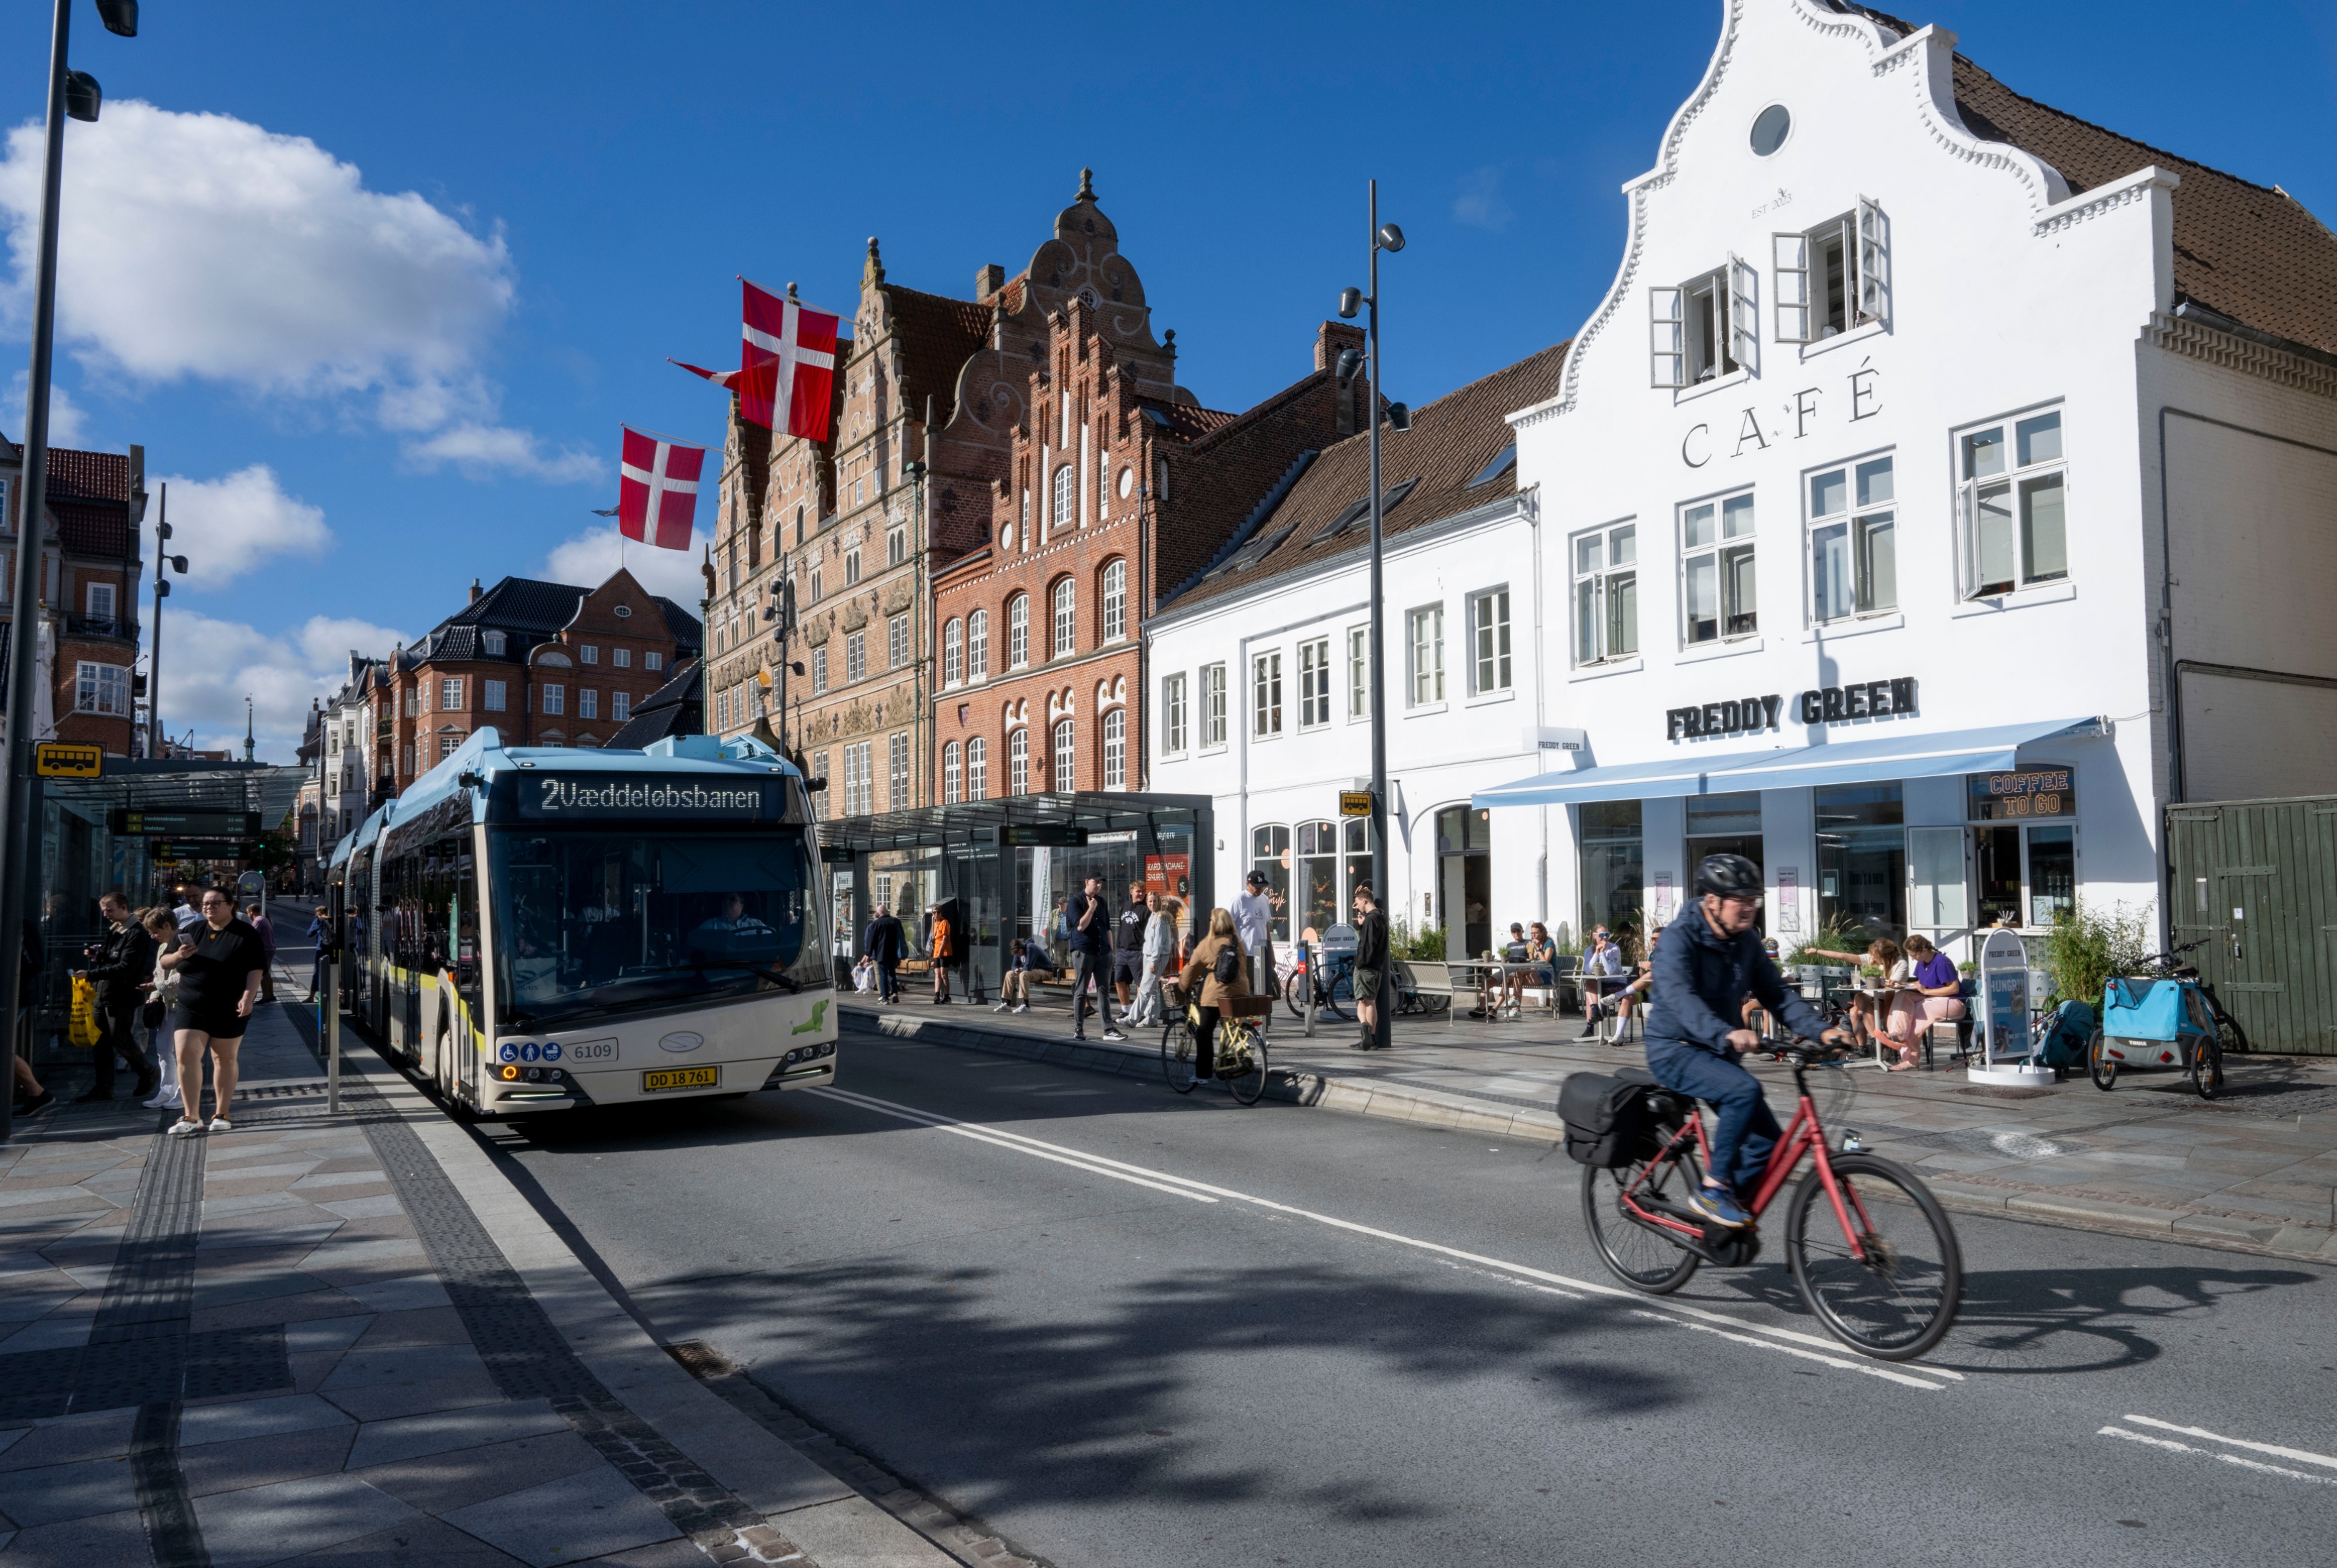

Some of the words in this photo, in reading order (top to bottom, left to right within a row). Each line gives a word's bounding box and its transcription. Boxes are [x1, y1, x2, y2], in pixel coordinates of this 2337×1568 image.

[1752, 204, 1768, 219] EST
[1772, 193, 1791, 210] 2023
[1682, 356, 1882, 468] CAFÉ
[1666, 695, 1779, 740] FREDDY
[1801, 677, 1916, 725] GREEN
[1990, 771, 2068, 794] COFFEE
[542, 780, 558, 809] 2
[561, 783, 760, 808] Væddeløbsbanen
[2003, 796, 2029, 815] TO
[2035, 794, 2060, 813] GO
[1157, 831, 1175, 841] Nytorv
[1849, 871, 1867, 885] There's
[1868, 873, 1872, 885] a
[574, 1044, 612, 1059] 6109
[650, 1075, 667, 1086] DD
[672, 1073, 685, 1085] 18
[689, 1070, 710, 1083] 761
